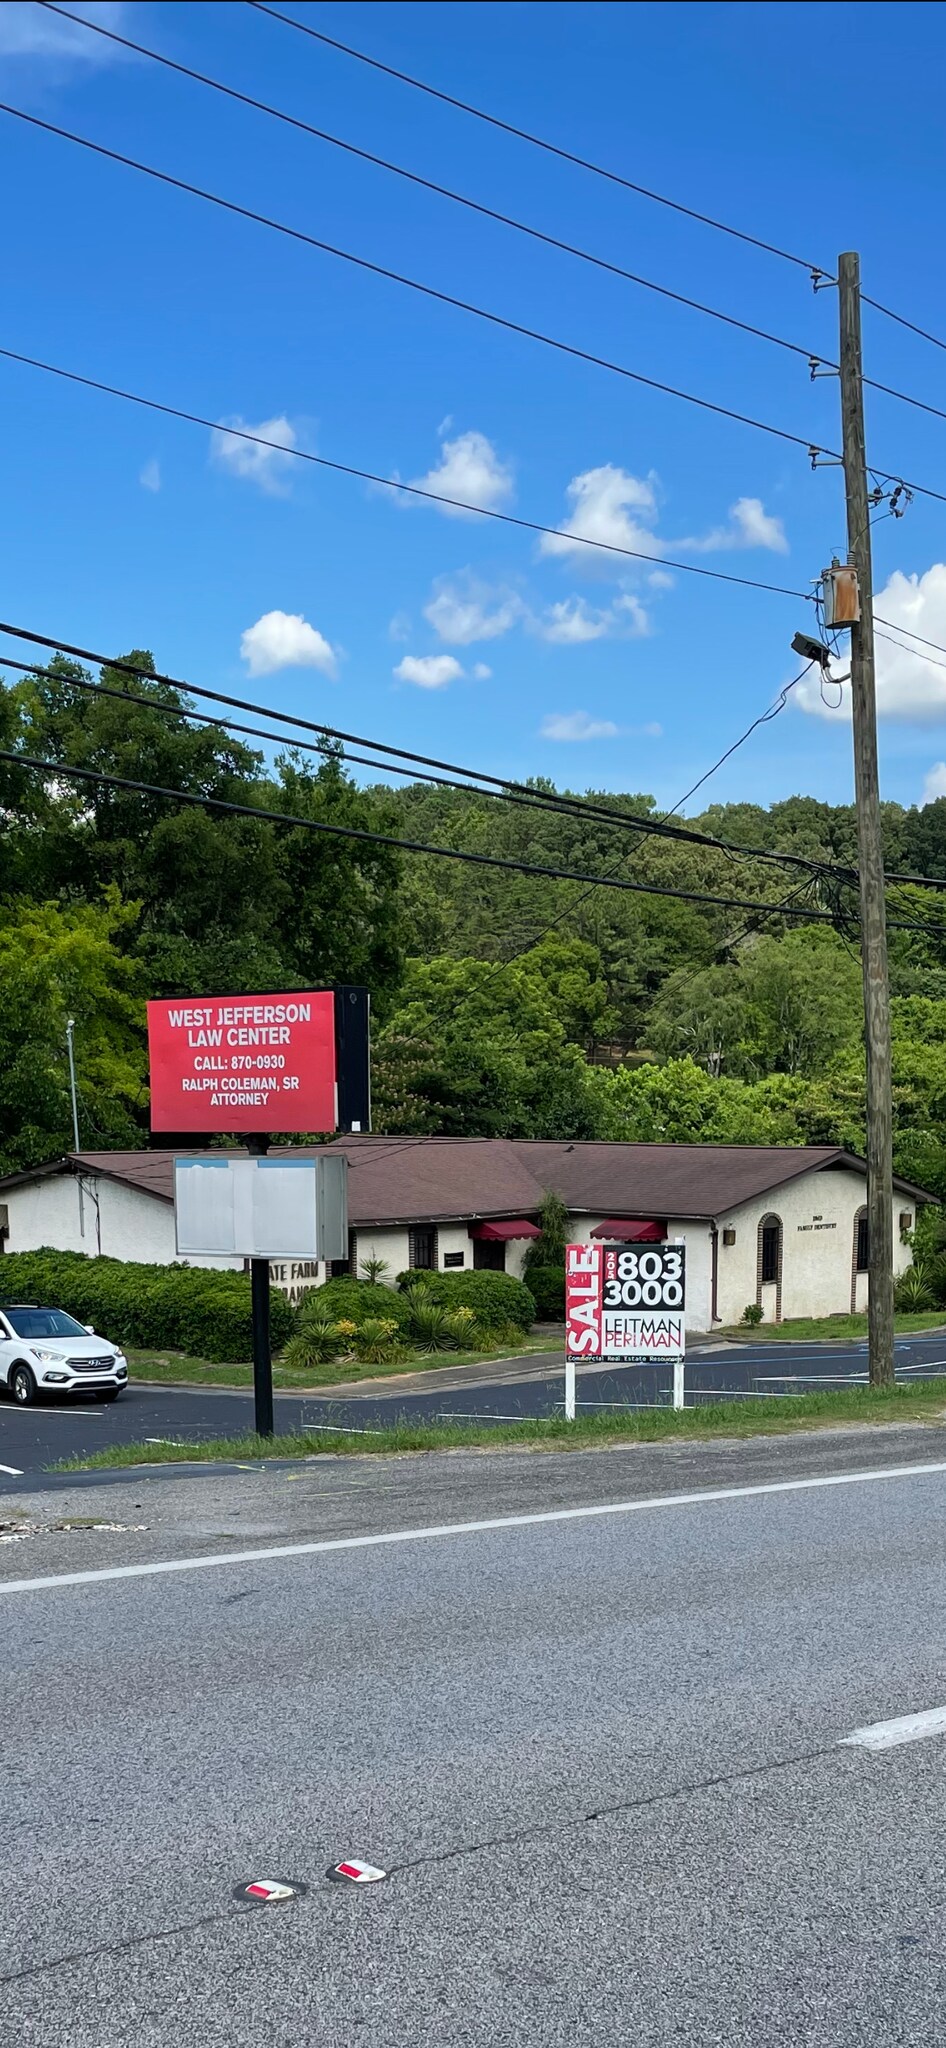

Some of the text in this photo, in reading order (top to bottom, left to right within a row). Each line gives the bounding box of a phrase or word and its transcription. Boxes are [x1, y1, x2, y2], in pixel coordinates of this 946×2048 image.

[168, 1004, 311, 1027] WEST JEFFERSON
[188, 1026, 291, 1047] LAW CENTER
[194, 1055, 285, 1070] CALL: 870-0930
[182, 1076, 299, 1092] RALPH COLEMAN, SR
[210, 1092, 269, 1106] ATTORNEY
[291, 1261, 318, 1279] FARM
[606, 1252, 616, 1280] 205
[617, 1252, 682, 1281] 803
[568, 1250, 600, 1352] SALE
[603, 1280, 683, 1306] 3000
[605, 1318, 681, 1333] LEITMAN
